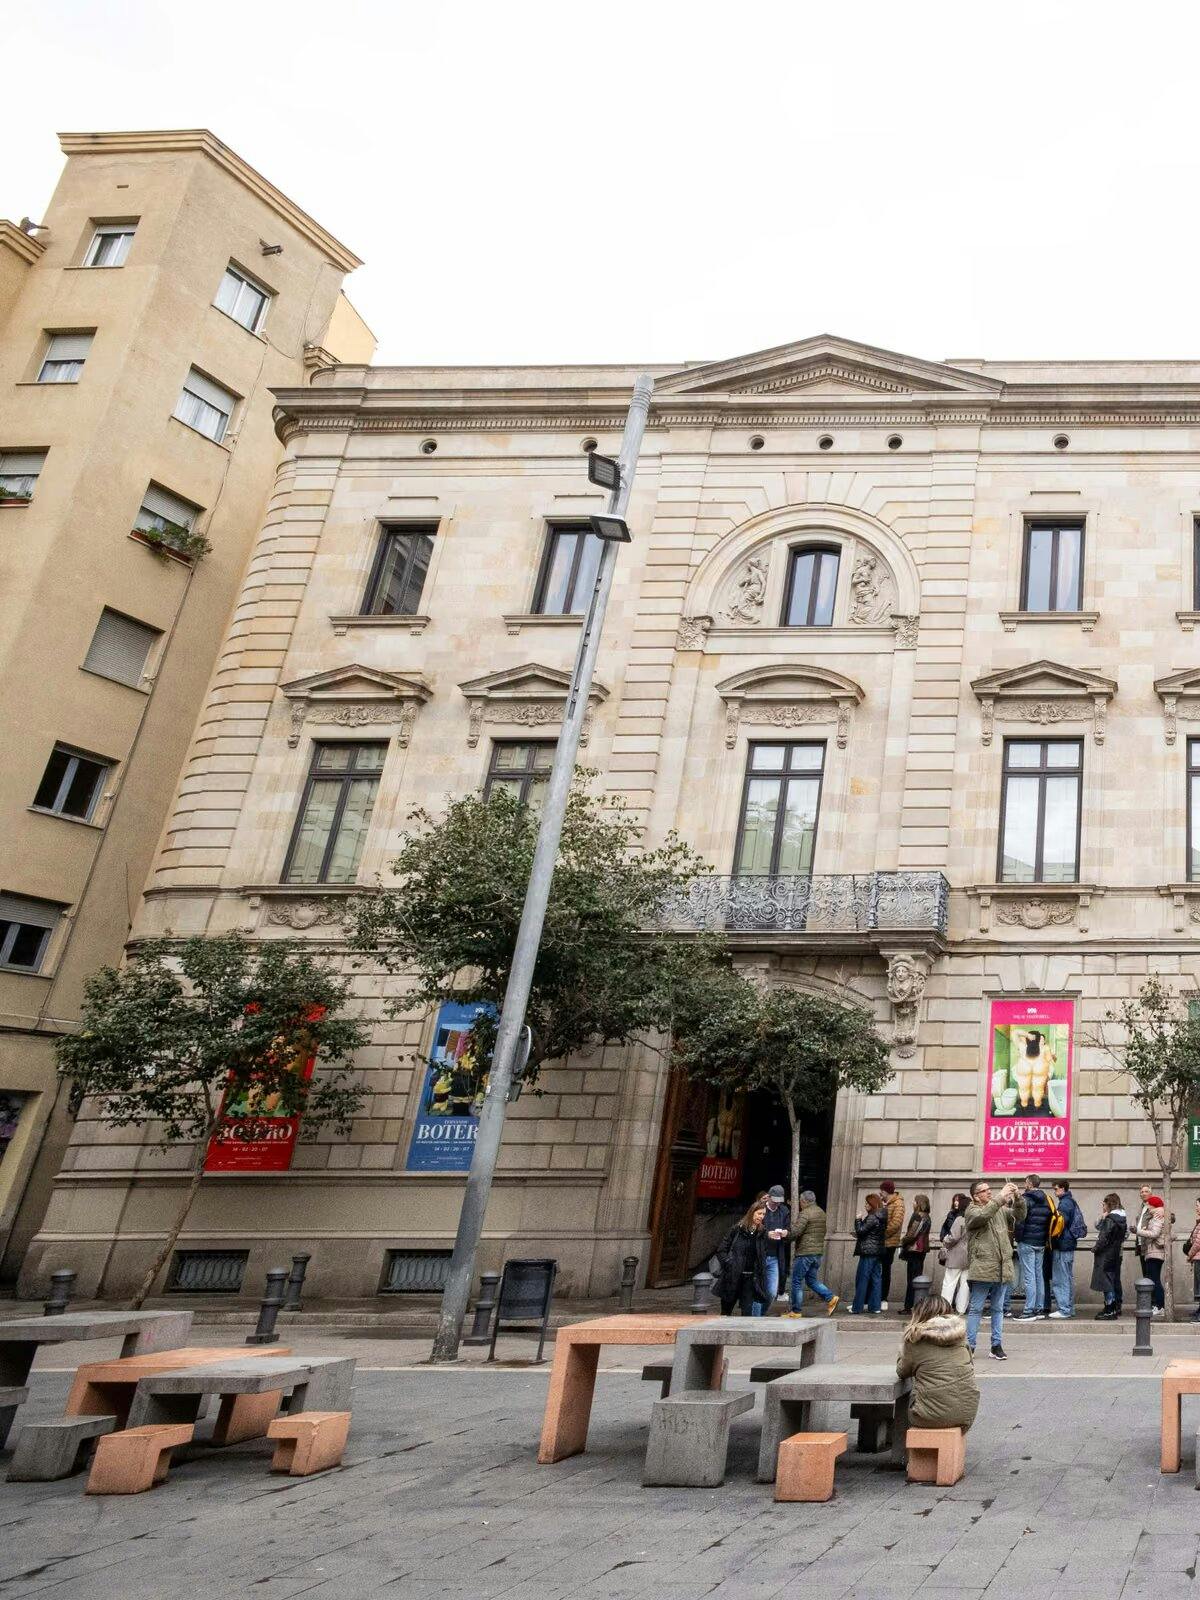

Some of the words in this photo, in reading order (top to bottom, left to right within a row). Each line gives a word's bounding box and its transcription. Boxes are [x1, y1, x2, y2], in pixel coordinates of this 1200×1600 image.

[417, 1124, 480, 1140] BOTER
[989, 1125, 1066, 1141] BOTERO
[701, 1164, 737, 1180] BOTERO
